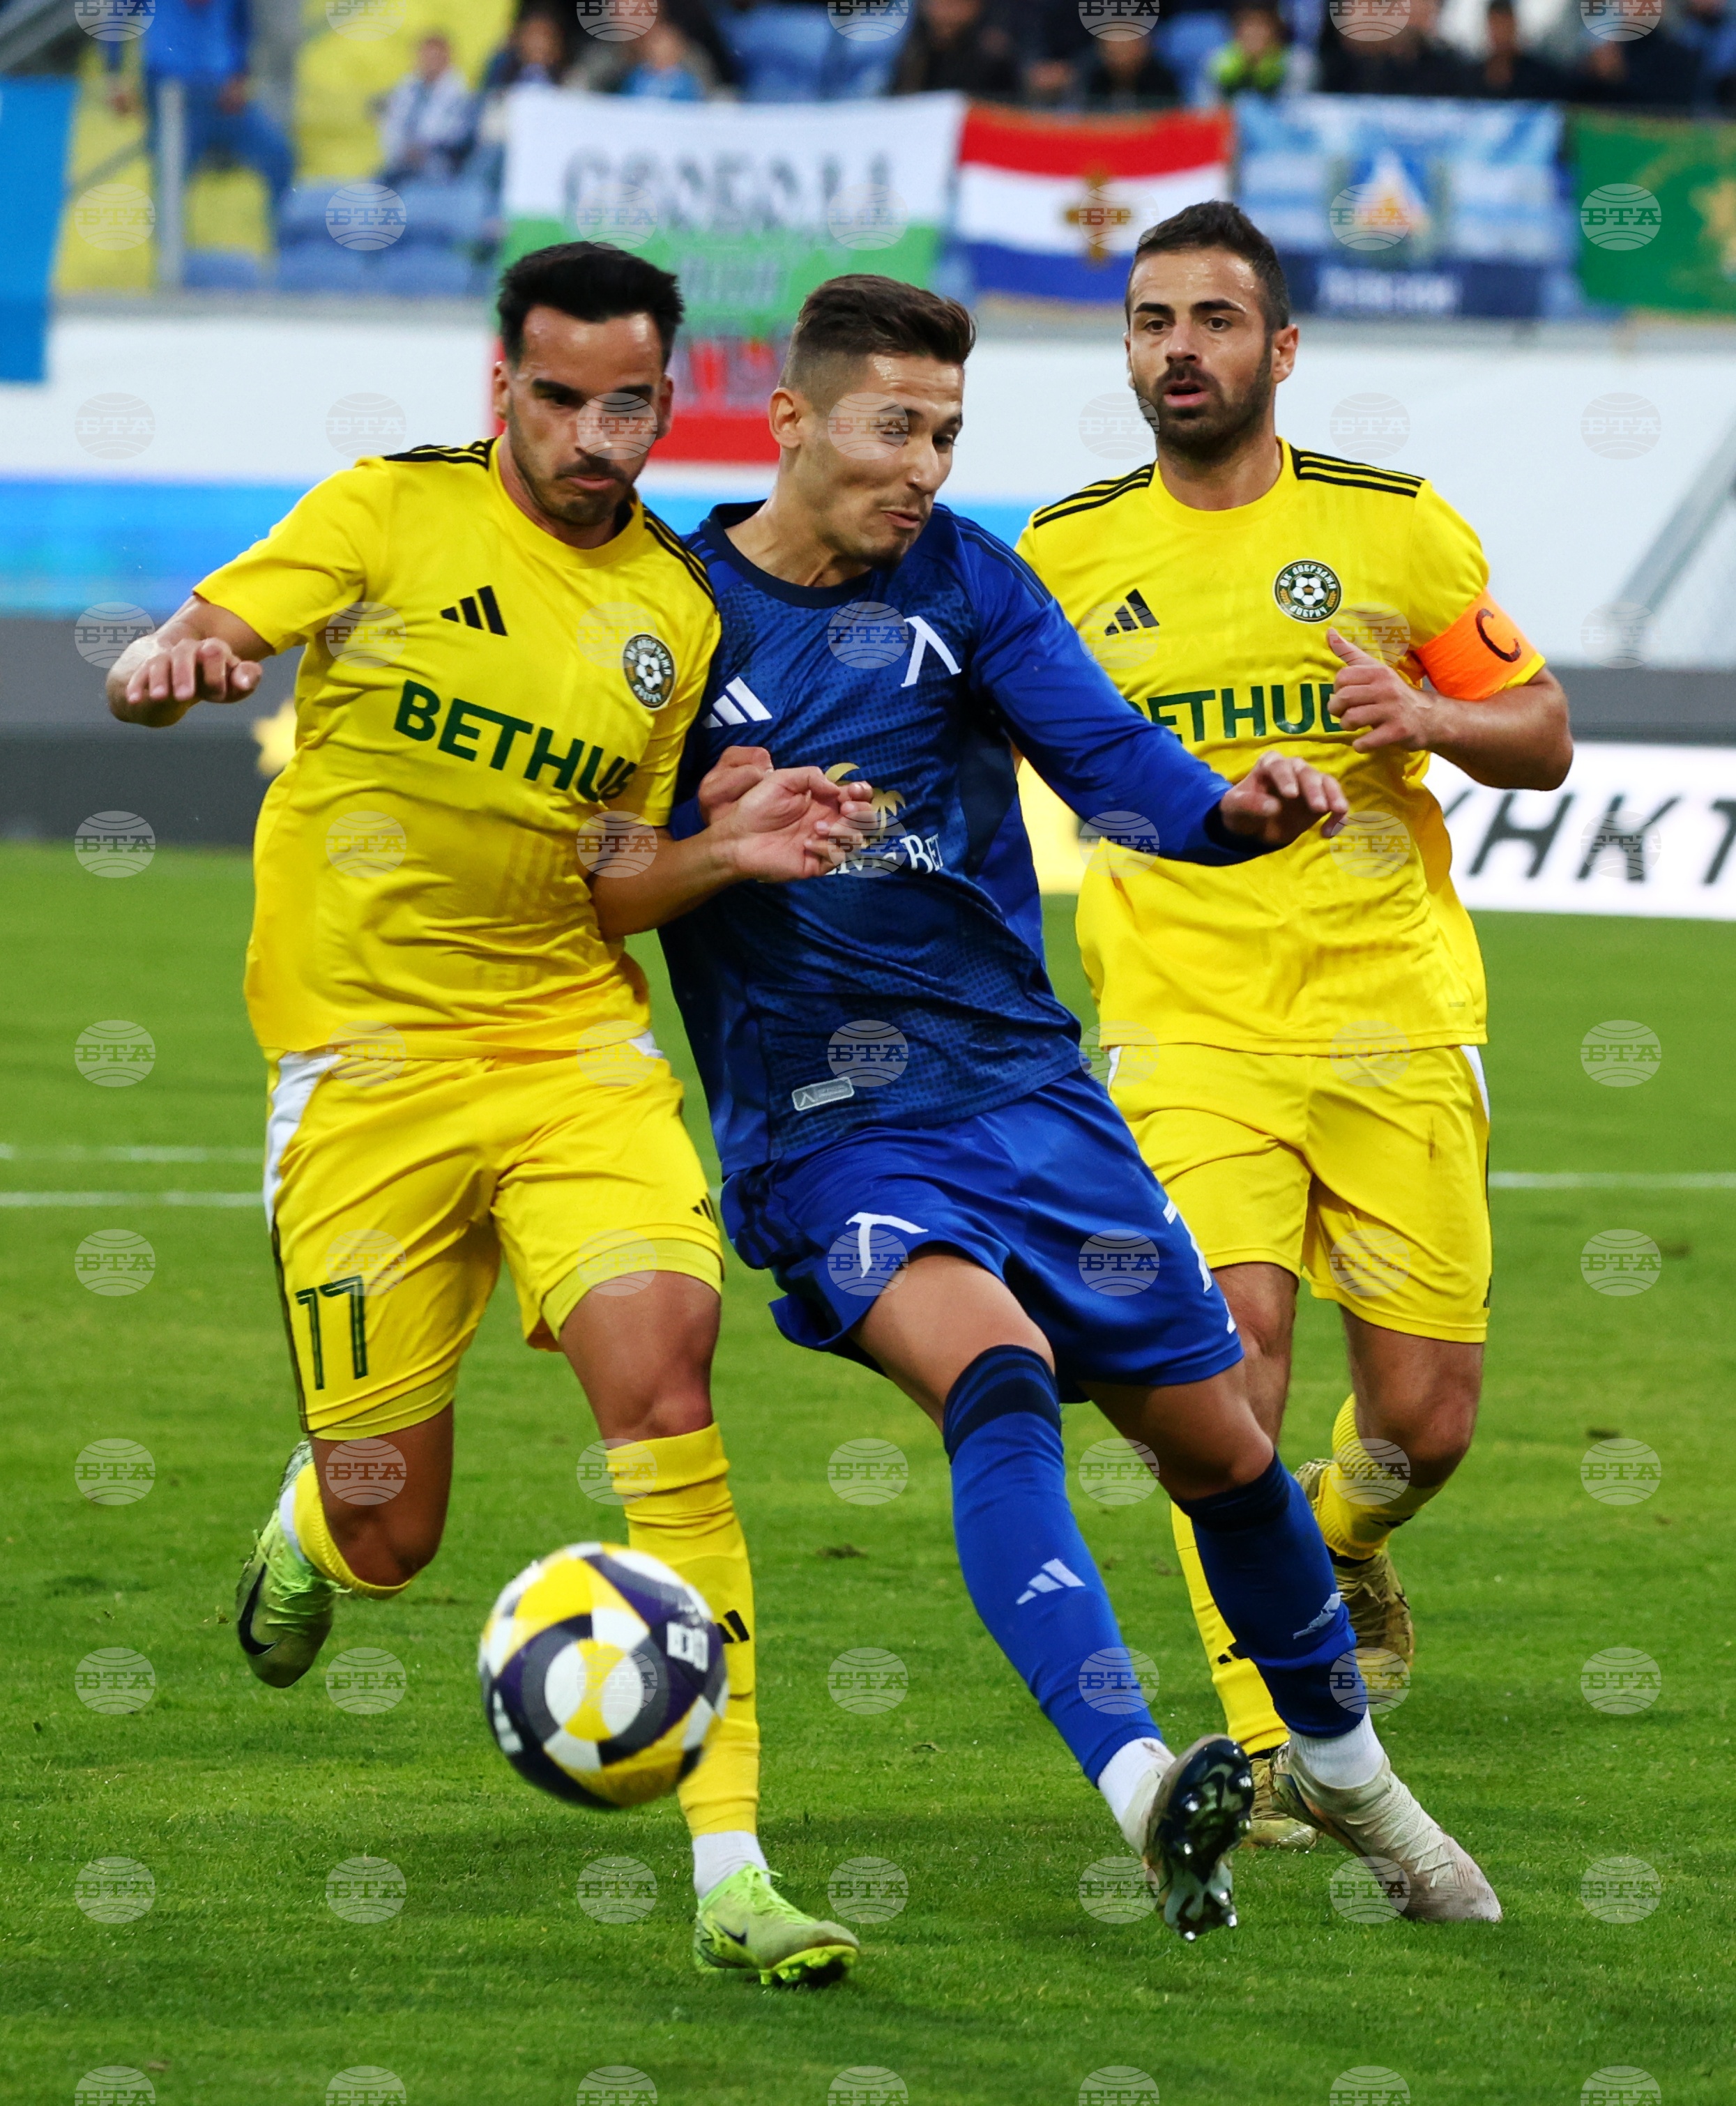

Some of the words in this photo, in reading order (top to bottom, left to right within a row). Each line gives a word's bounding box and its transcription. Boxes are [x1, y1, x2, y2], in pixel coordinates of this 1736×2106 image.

[1475, 608, 1521, 662] C
[1127, 683, 1343, 744] ETHU
[295, 1275, 368, 1390] 17
